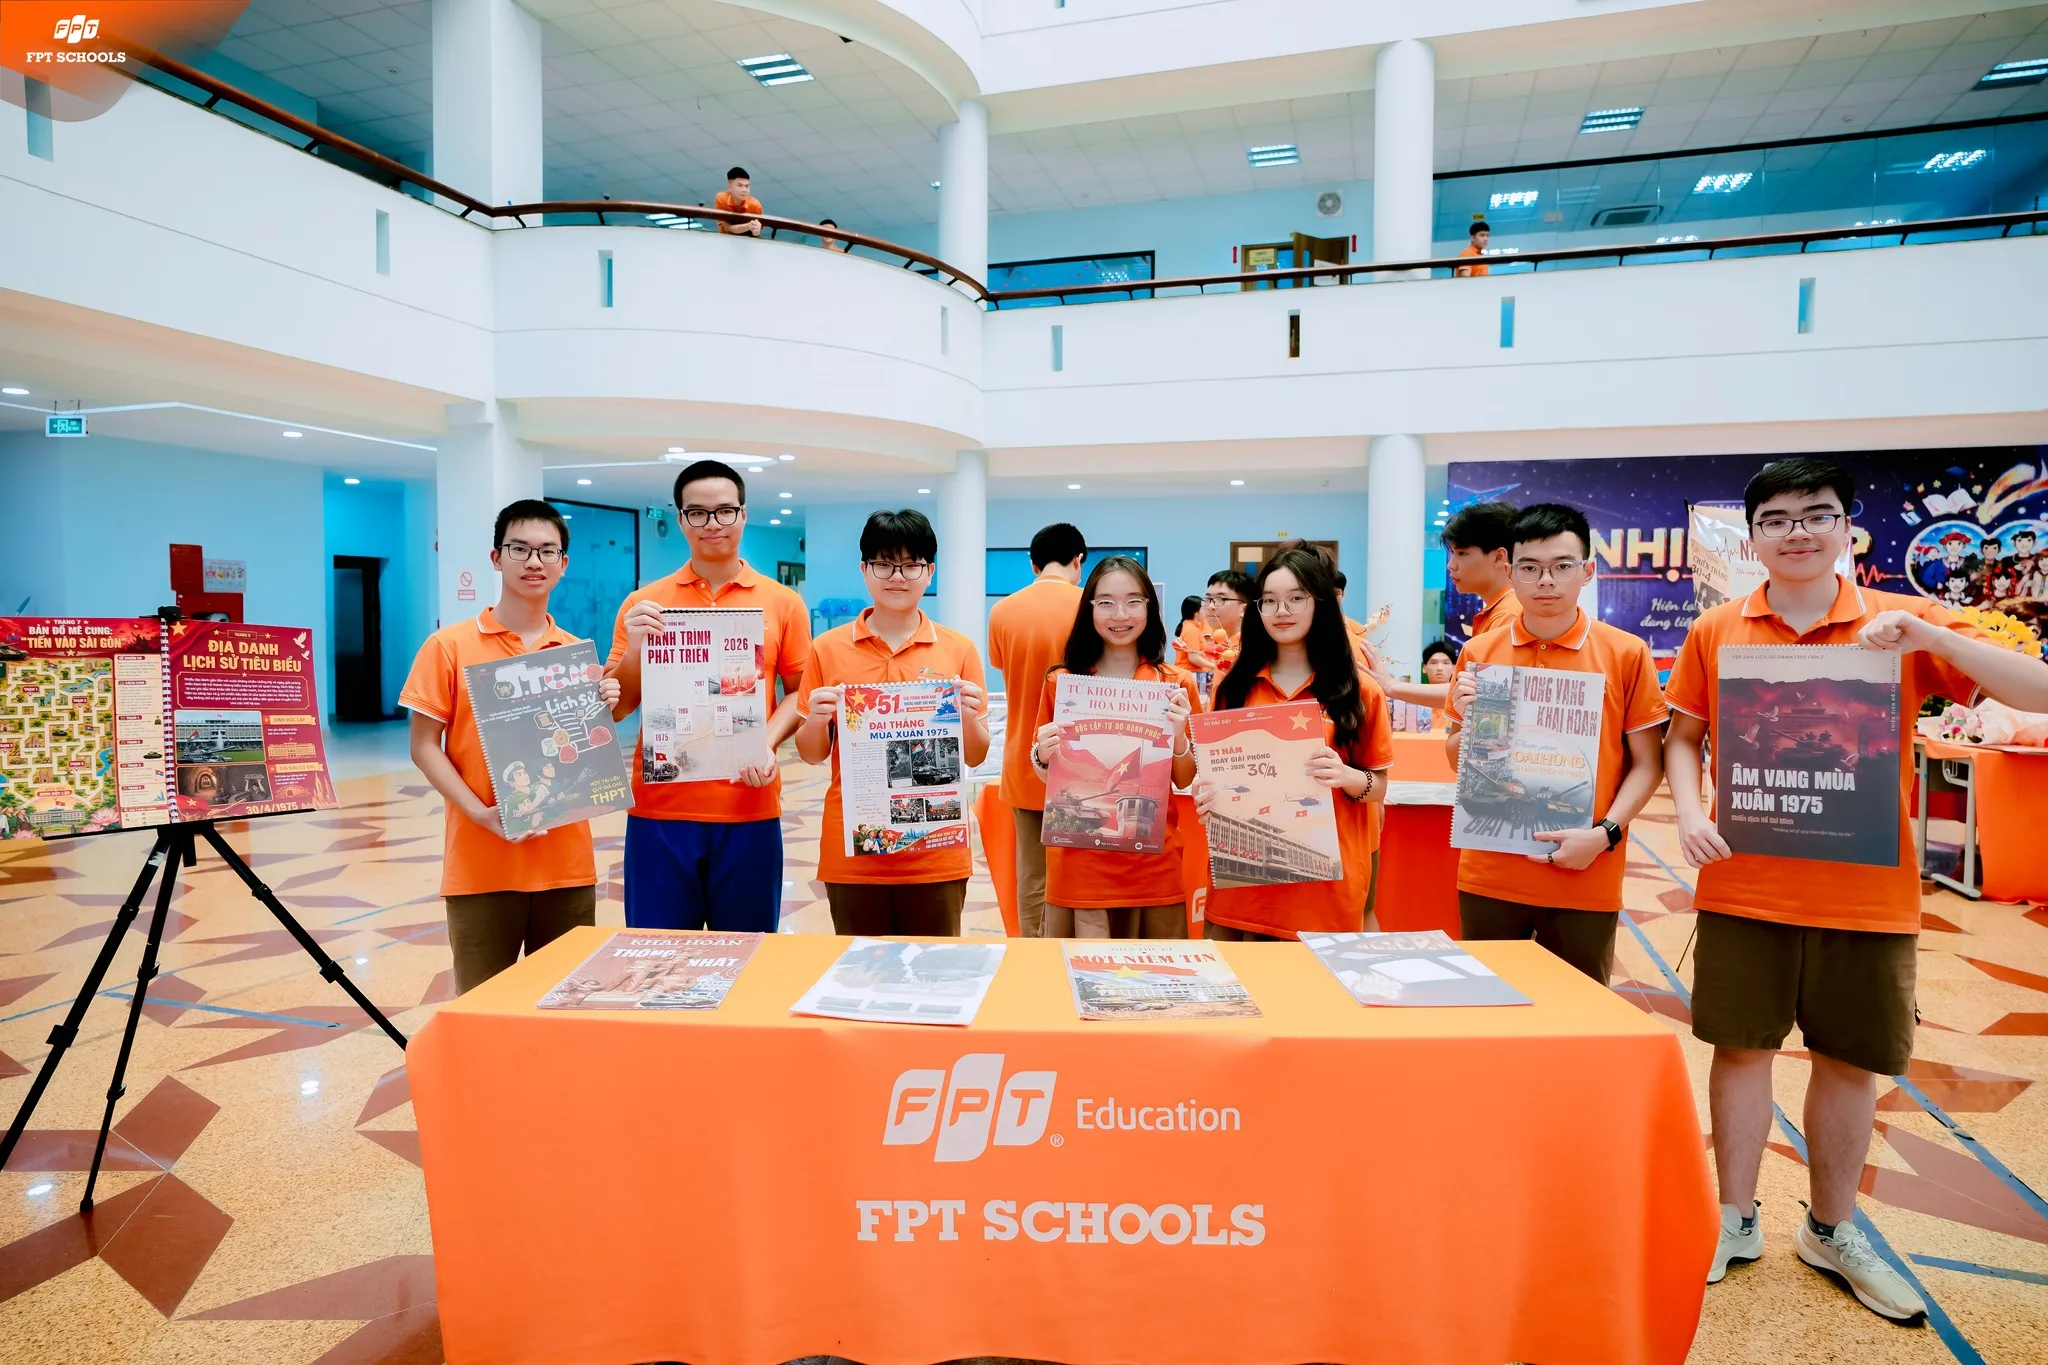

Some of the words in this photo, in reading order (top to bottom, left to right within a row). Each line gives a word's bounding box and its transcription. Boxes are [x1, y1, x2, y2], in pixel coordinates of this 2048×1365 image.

[1691, 563, 1711, 582] 30-4
[1651, 597, 1680, 613] Hiện
[29, 624, 49, 635] BẢN
[52, 623, 66, 635] ĐỒ
[68, 624, 82, 635] MÊ
[85, 626, 113, 635] CUNG:
[1640, 614, 1671, 631] đang
[55, 636, 76, 648] VÀO
[79, 636, 97, 648] SÀI
[680, 628, 711, 646] TRÌNH
[724, 637, 749, 651] 2026
[208, 639, 235, 655] ĐỊA
[238, 641, 279, 656] DANH
[648, 646, 676, 664] PHÁT
[679, 645, 709, 663] TRIỂN
[182, 654, 216, 671] LỊCH
[219, 654, 240, 670] SỬ
[240, 656, 270, 672] TIÊU
[272, 656, 302, 673] BIỂU
[1068, 682, 1085, 694] TỪ
[1087, 686, 1117, 698] KHÓI
[1556, 677, 1586, 706] VANG
[545, 695, 578, 714] Lịch
[716, 705, 728, 713] 1995
[877, 694, 901, 715] 51
[1090, 698, 1115, 711] HÒA
[1118, 700, 1148, 713] BÌNH
[869, 719, 887, 732] ĐẠI
[890, 716, 925, 729] THẮNG
[1075, 723, 1088, 734] ĐỘC
[1144, 728, 1162, 740] PHÚC
[655, 733, 669, 742] 1975
[870, 729, 893, 740] MÙA
[896, 728, 924, 739] XUÂN
[926, 727, 949, 737] 1975
[1209, 748, 1220, 756] 51
[1222, 746, 1243, 755] NĂM
[1210, 756, 1229, 765] NGÀY
[1230, 753, 1245, 763] GIẢI
[1246, 752, 1271, 761] PHÓNG
[1731, 762, 1759, 786] ÂM
[1763, 769, 1809, 789] VANG
[1814, 767, 1856, 792] MÙA
[590, 787, 626, 806] THPT
[1731, 788, 1775, 812] XUÂN
[1779, 794, 1823, 815] 1975
[245, 801, 298, 815] 30/4/1975
[1731, 813, 1747, 822] Chiến
[1761, 815, 1769, 824] Hồ
[1769, 816, 1779, 825] Chí
[1779, 817, 1794, 825] Minh
[613, 946, 677, 959] THỐNG
[1123, 954, 1175, 964] NIỀM
[1178, 952, 1217, 963] TIN
[686, 955, 740, 967] NHẤT
[1077, 1096, 1242, 1132] Education
[855, 1200, 966, 1242] FPT
[983, 1200, 1267, 1246] SCHOOLS
